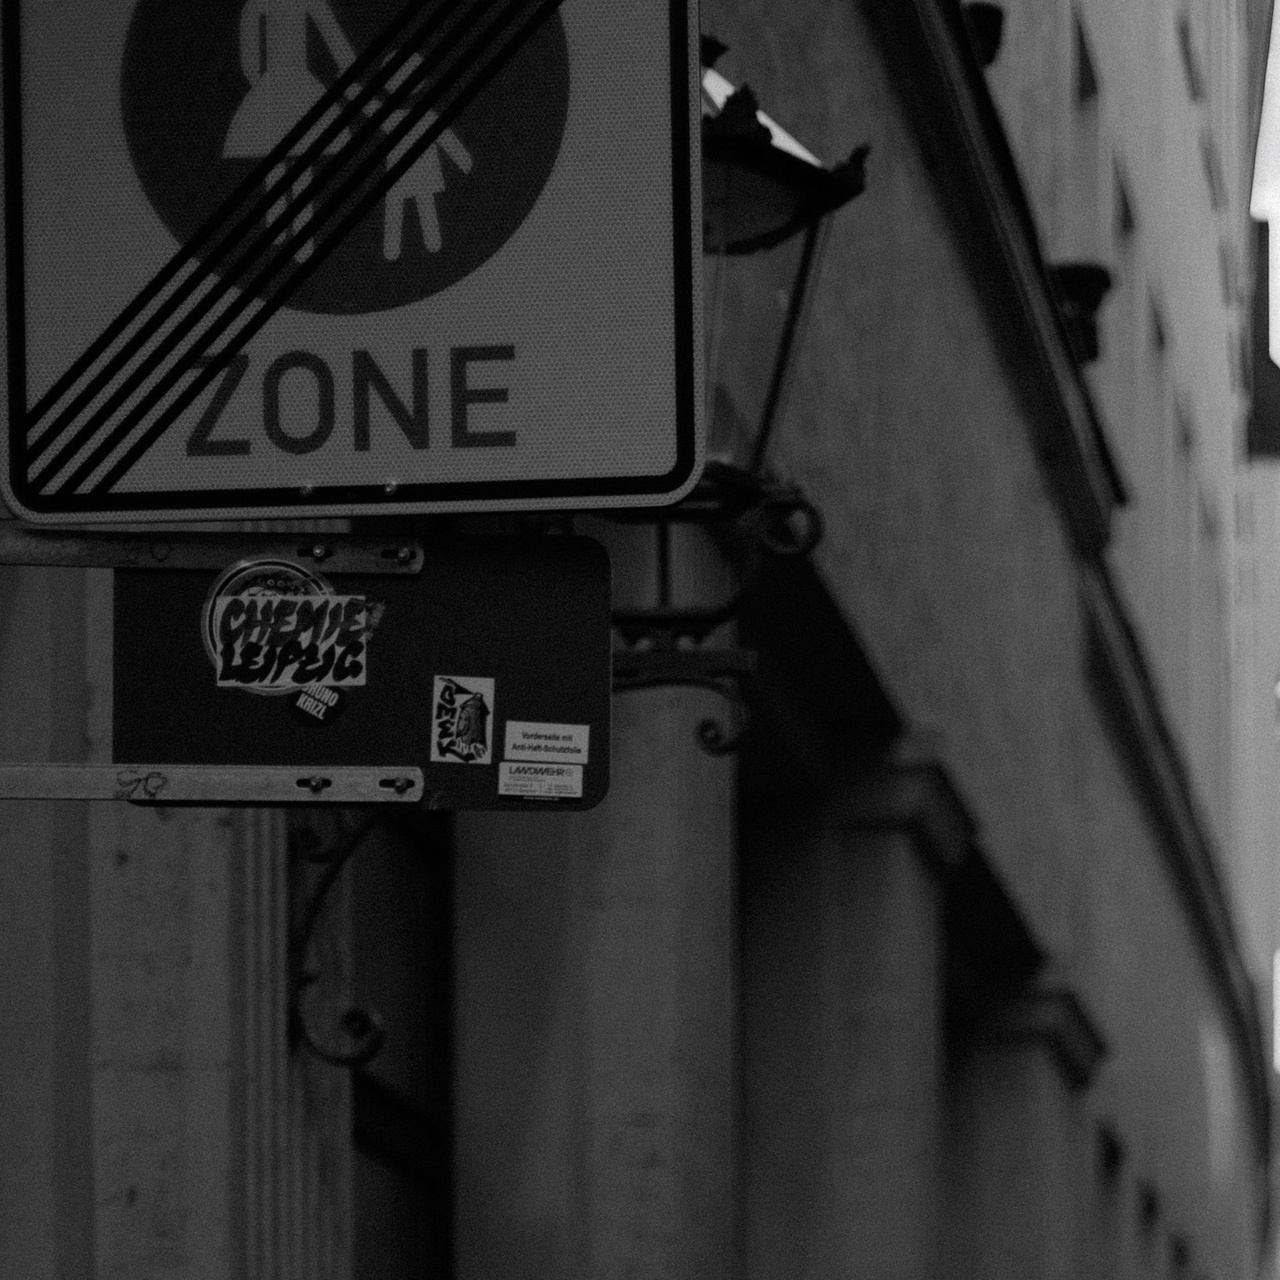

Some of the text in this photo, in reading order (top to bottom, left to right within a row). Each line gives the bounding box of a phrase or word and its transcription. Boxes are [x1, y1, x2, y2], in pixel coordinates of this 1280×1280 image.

[185, 344, 518, 456] ZONE
[218, 639, 366, 684] LEIPZIG
[562, 734, 574, 743] mit
